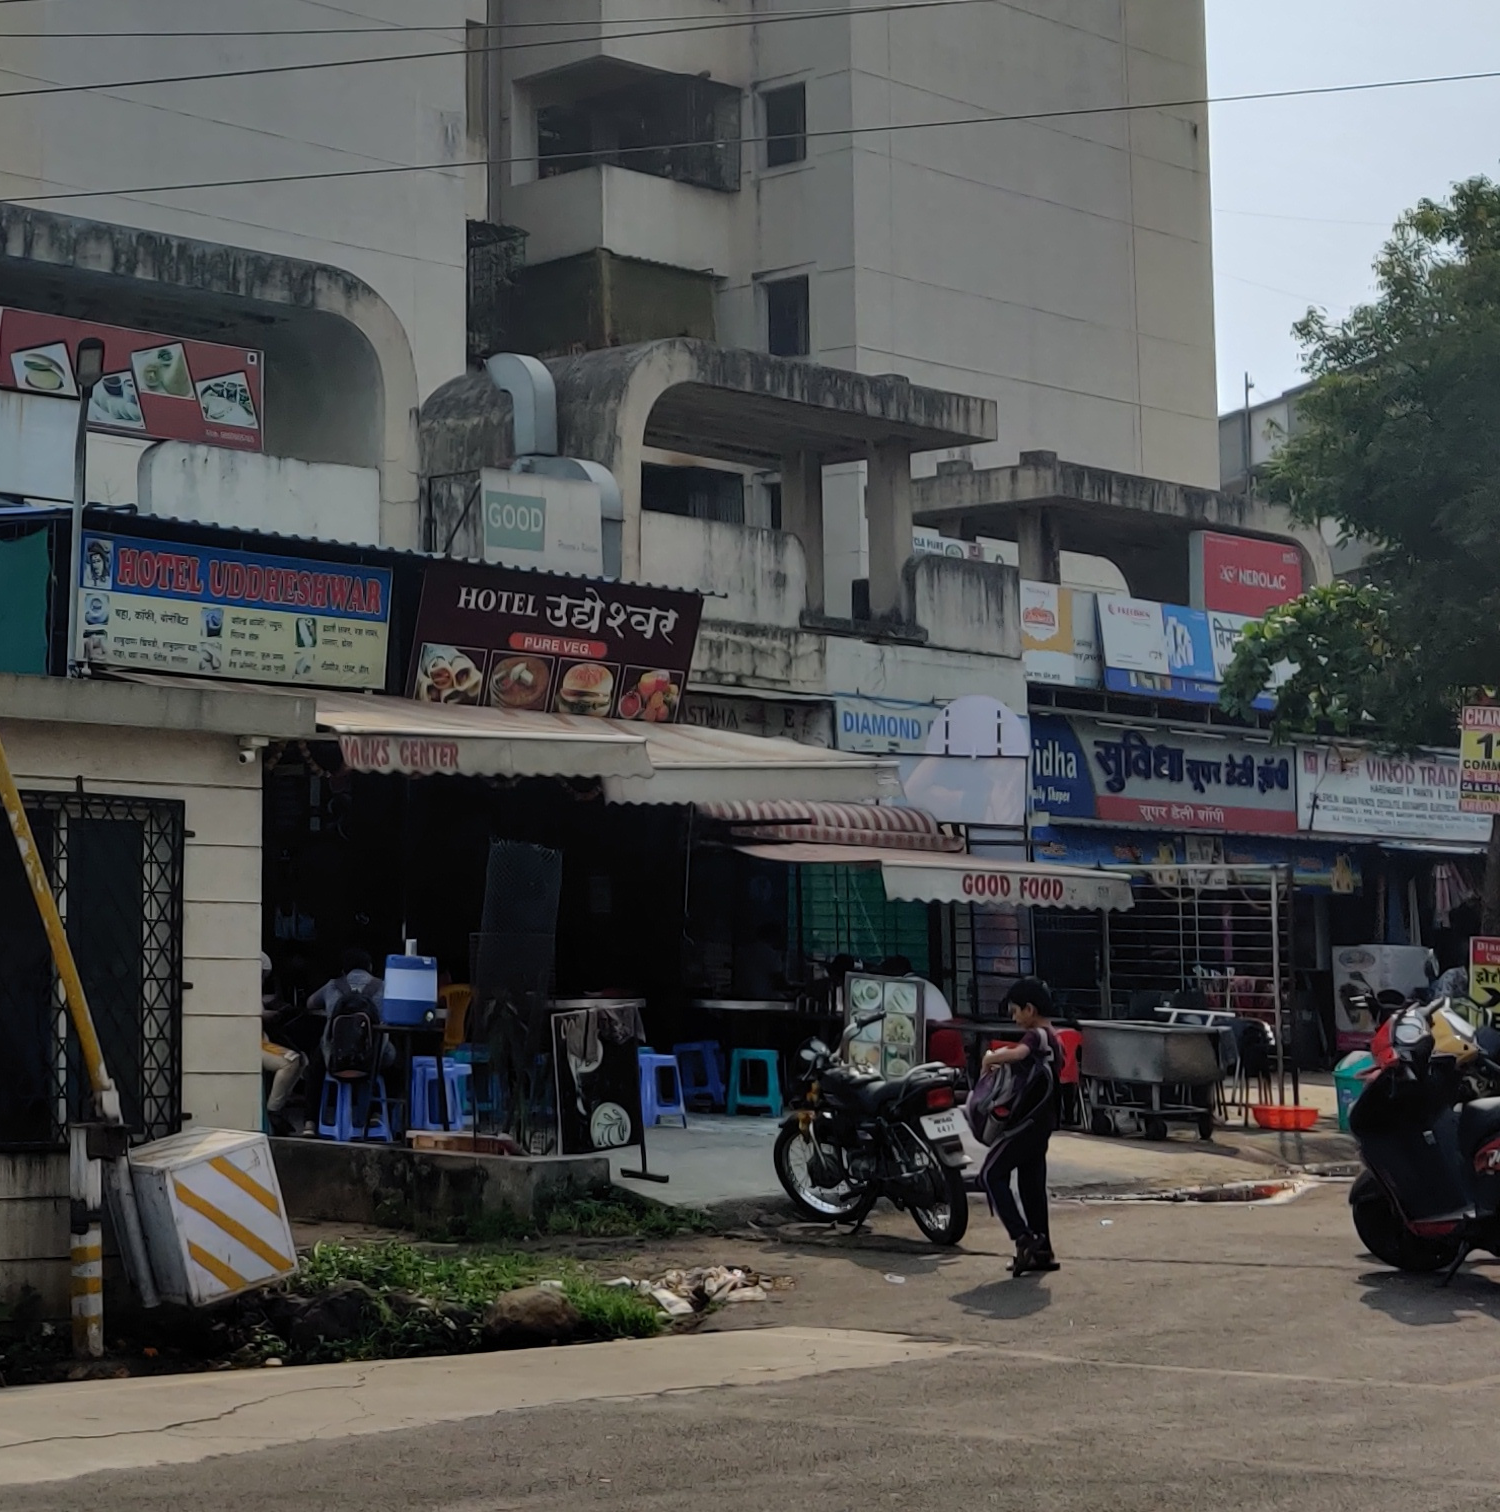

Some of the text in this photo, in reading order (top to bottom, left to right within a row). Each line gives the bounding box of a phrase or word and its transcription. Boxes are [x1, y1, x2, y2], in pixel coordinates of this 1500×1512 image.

[488, 502, 543, 532] GOOD
[117, 548, 382, 615] HOTEL UDDHESHWAR
[1239, 568, 1286, 590] NEROLAC
[457, 586, 539, 617] HOTEL
[524, 636, 592, 655] PURE VEG.
[843, 711, 921, 739] DIAMOND
[400, 740, 459, 768] CENTER
[1094, 729, 1184, 792] सुविधा
[1367, 759, 1414, 785] VINOD
[1419, 766, 1459, 788] TRAD
[963, 874, 1063, 900] GOOD FOOD
